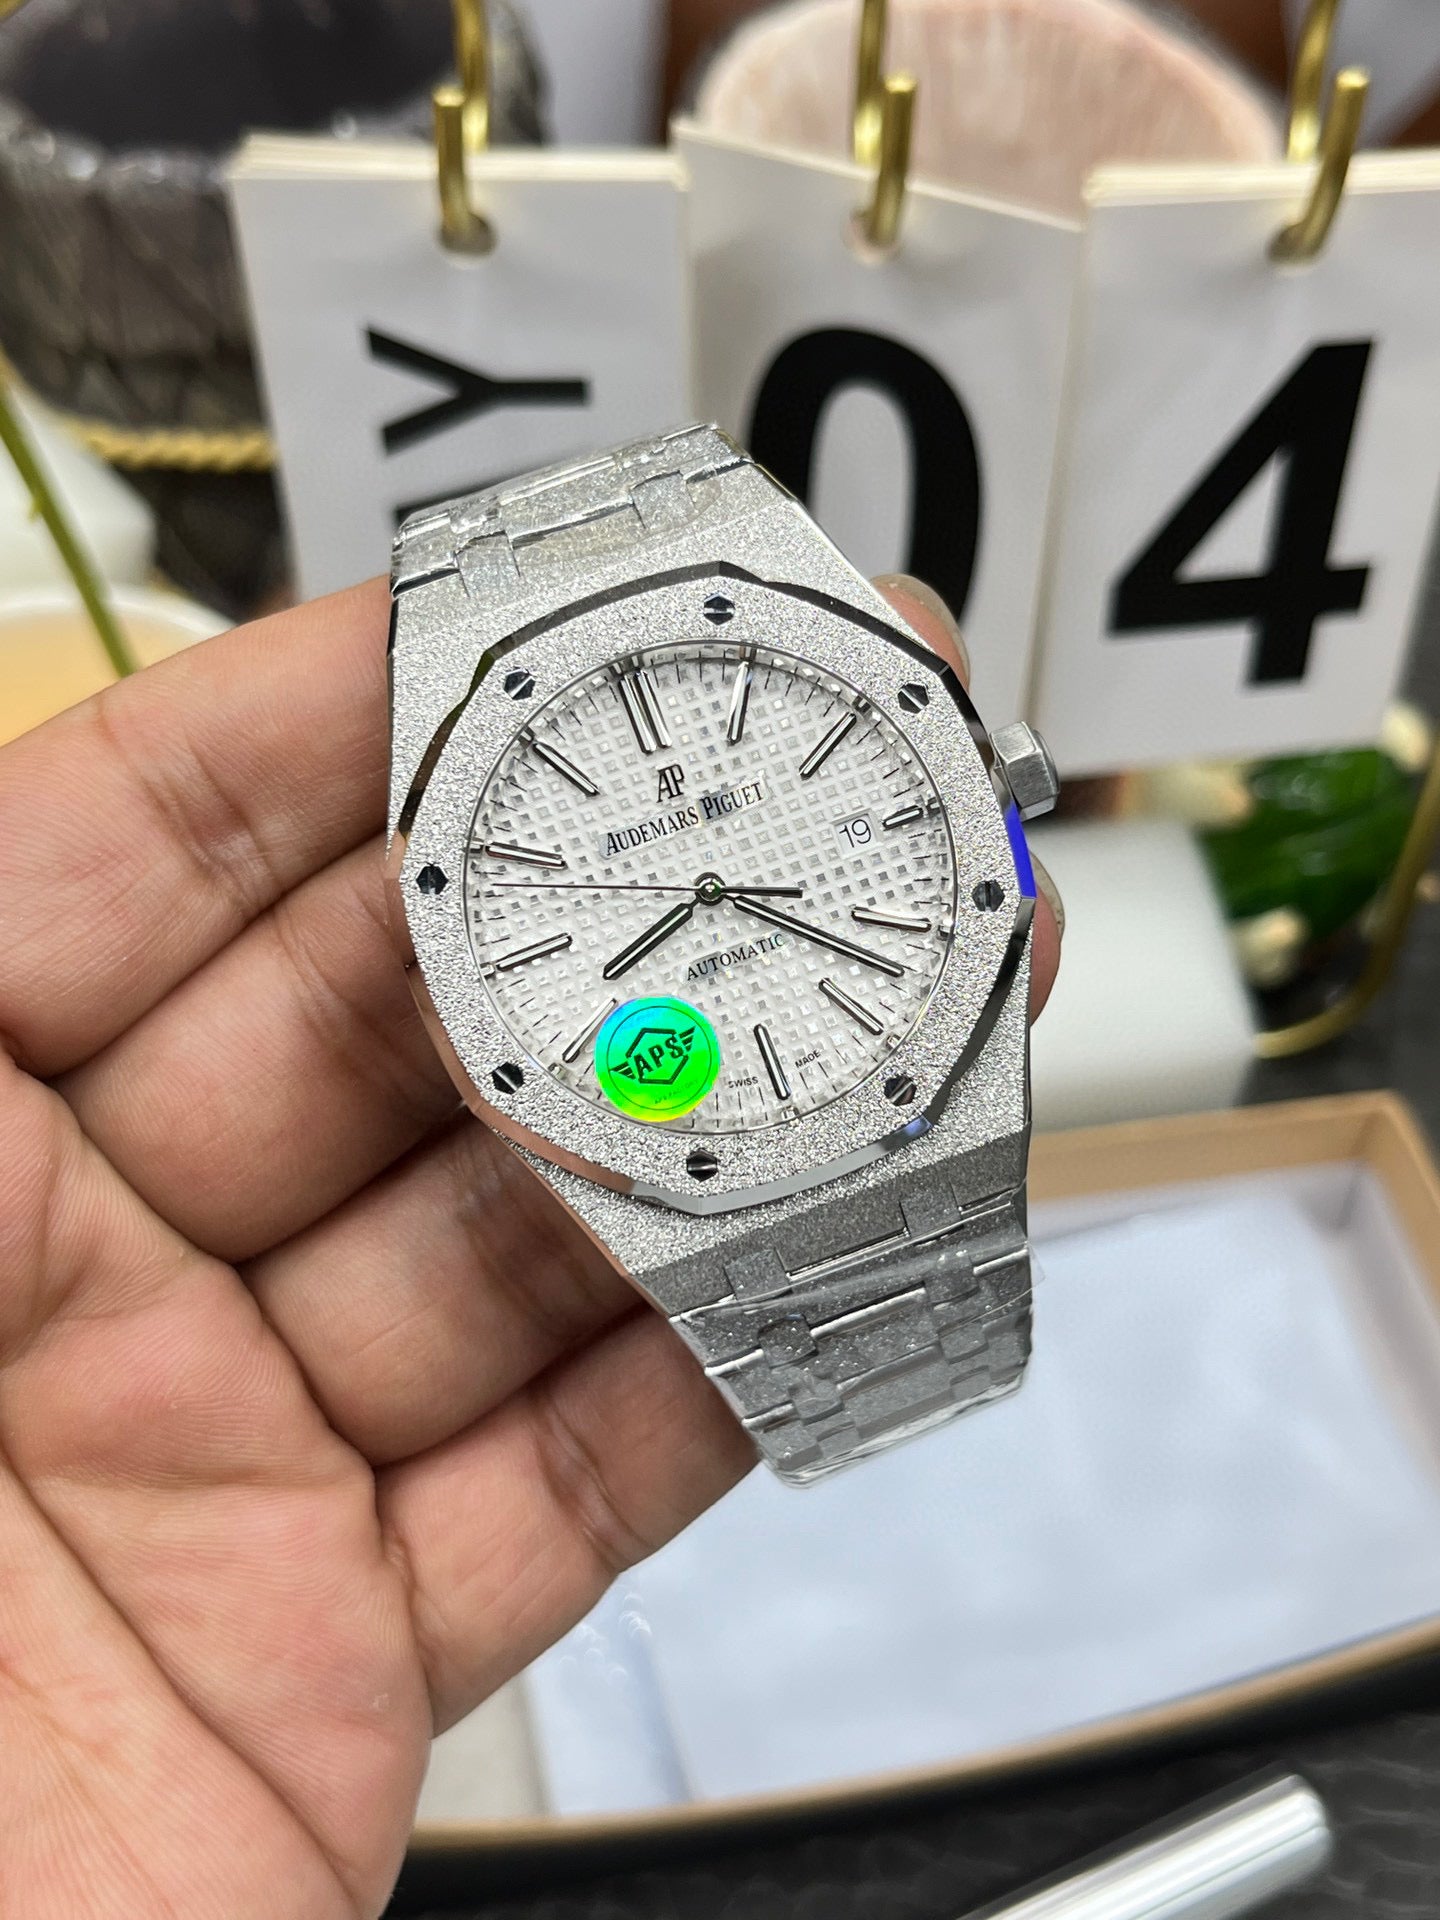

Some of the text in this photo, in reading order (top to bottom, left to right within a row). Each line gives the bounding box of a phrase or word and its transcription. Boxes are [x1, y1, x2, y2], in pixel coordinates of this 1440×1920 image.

[747, 326, 979, 626] 0
[1106, 340, 1373, 685] 4
[656, 764, 686, 803] AP
[605, 781, 765, 857] AUDEMARS PIGUET
[838, 818, 873, 848] 19
[685, 933, 785, 981] AUTOMATIC
[633, 1036, 684, 1080] APS
[727, 1049, 822, 1088] SWISS MADE
